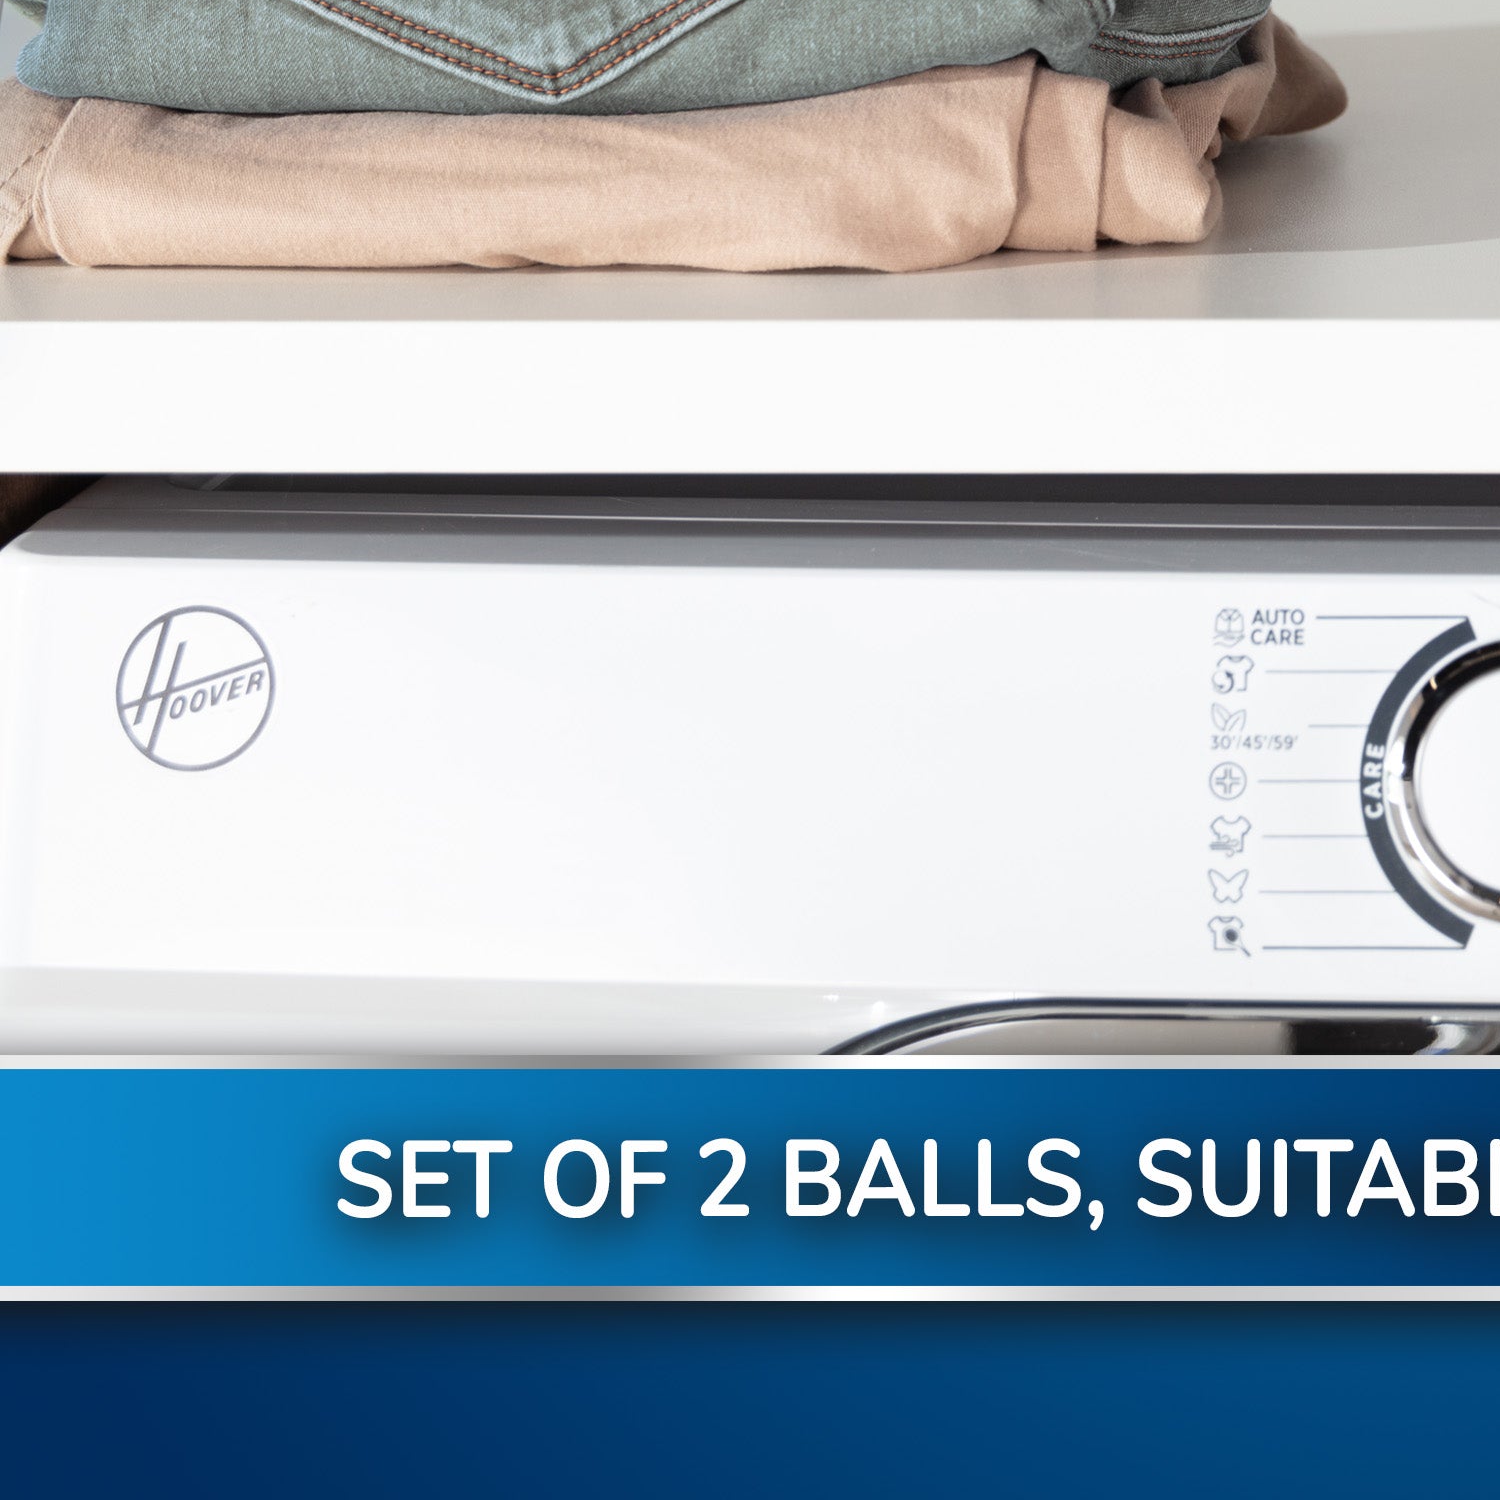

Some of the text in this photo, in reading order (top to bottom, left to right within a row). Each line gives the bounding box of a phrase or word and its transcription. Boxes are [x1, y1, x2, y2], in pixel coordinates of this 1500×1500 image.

[1250, 628, 1305, 646] CARE
[1251, 608, 1305, 626] AUTO
[120, 614, 266, 756] HOOVER
[1363, 742, 1386, 820] CARE
